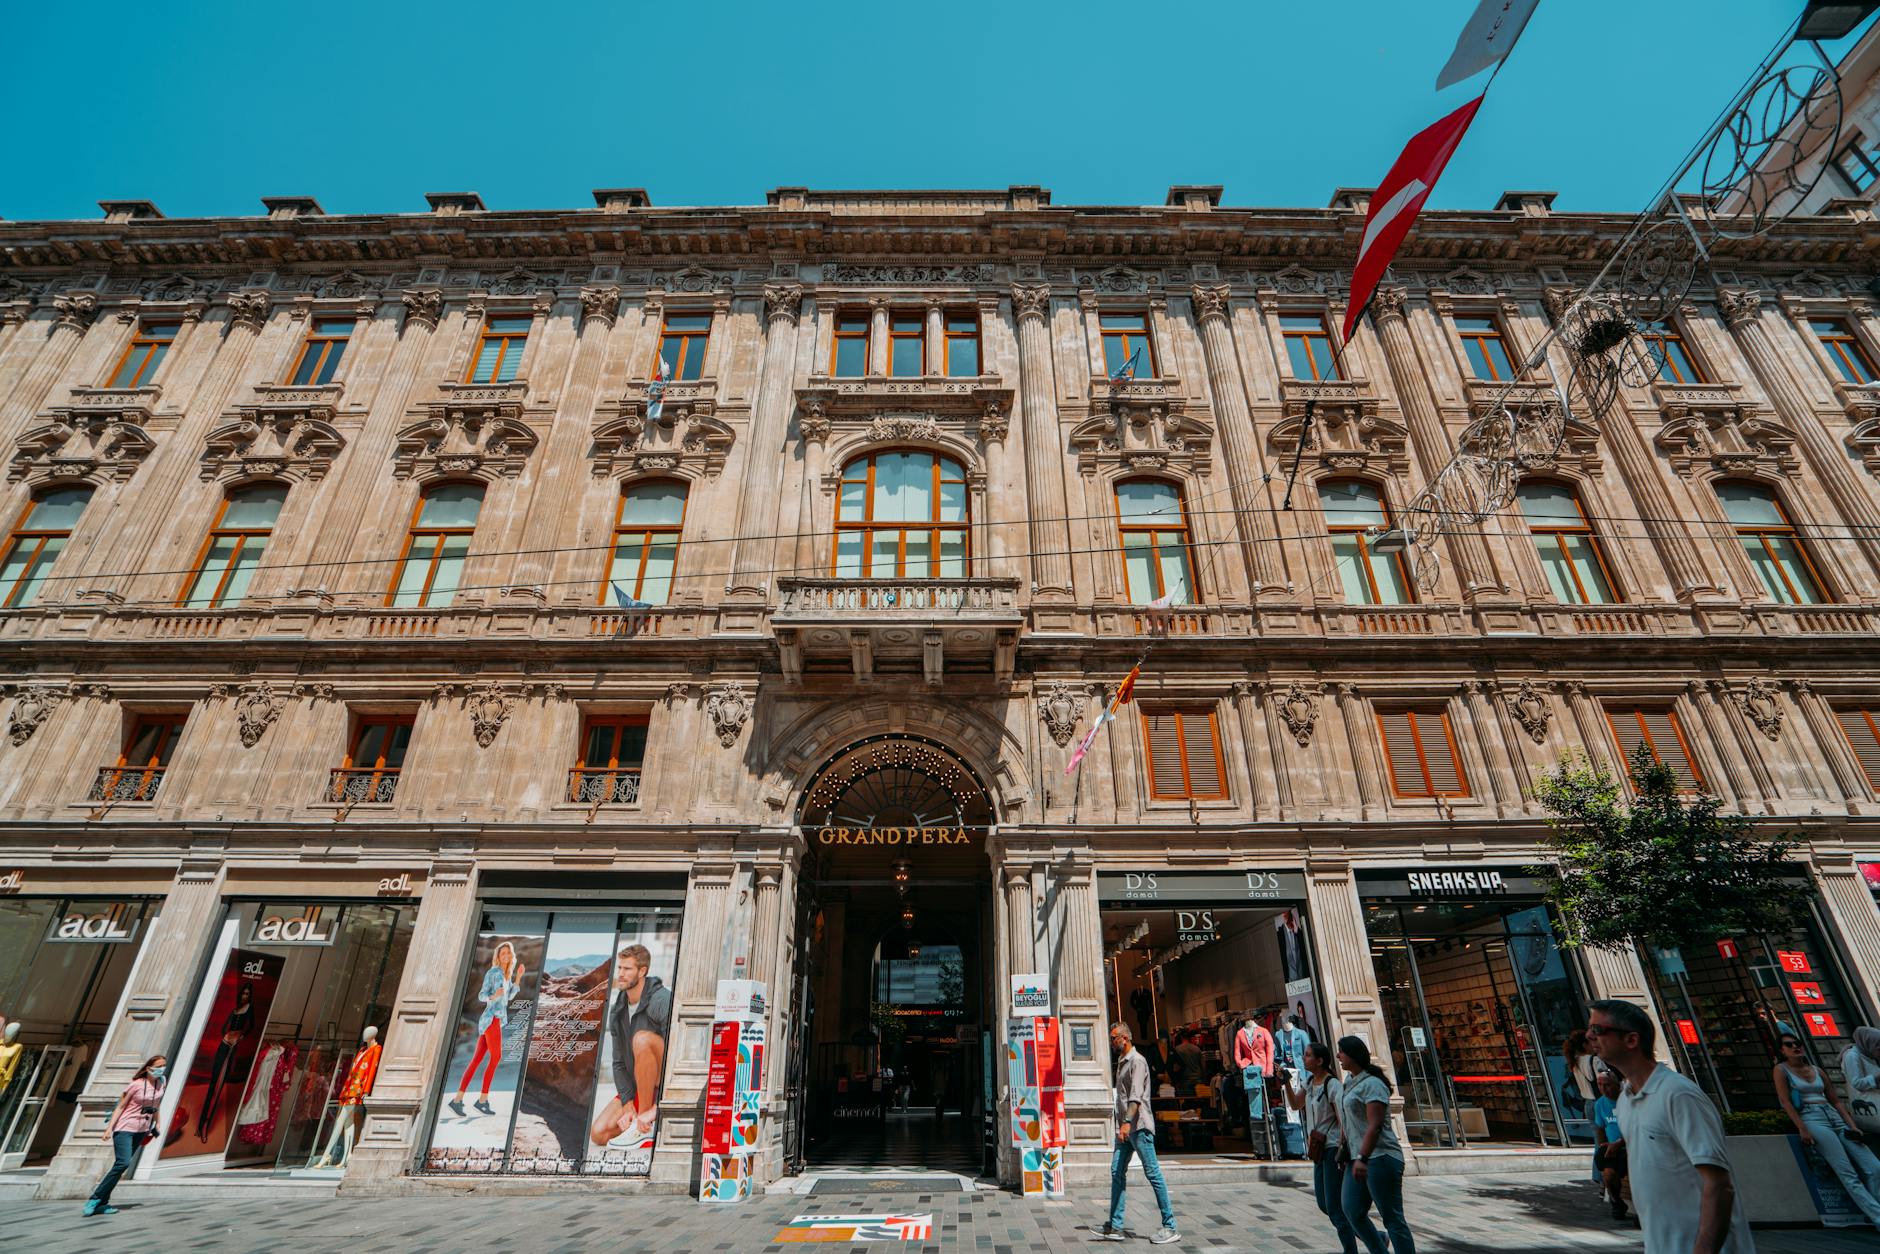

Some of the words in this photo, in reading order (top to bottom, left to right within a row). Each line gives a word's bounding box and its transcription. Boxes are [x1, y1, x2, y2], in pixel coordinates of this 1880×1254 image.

[818, 827, 901, 844] GRAND
[906, 827, 970, 844] PERA
[1125, 872, 1158, 889] D'S
[1246, 872, 1279, 889] D'S
[1177, 911, 1214, 931] D'S
[1179, 933, 1215, 941] damat
